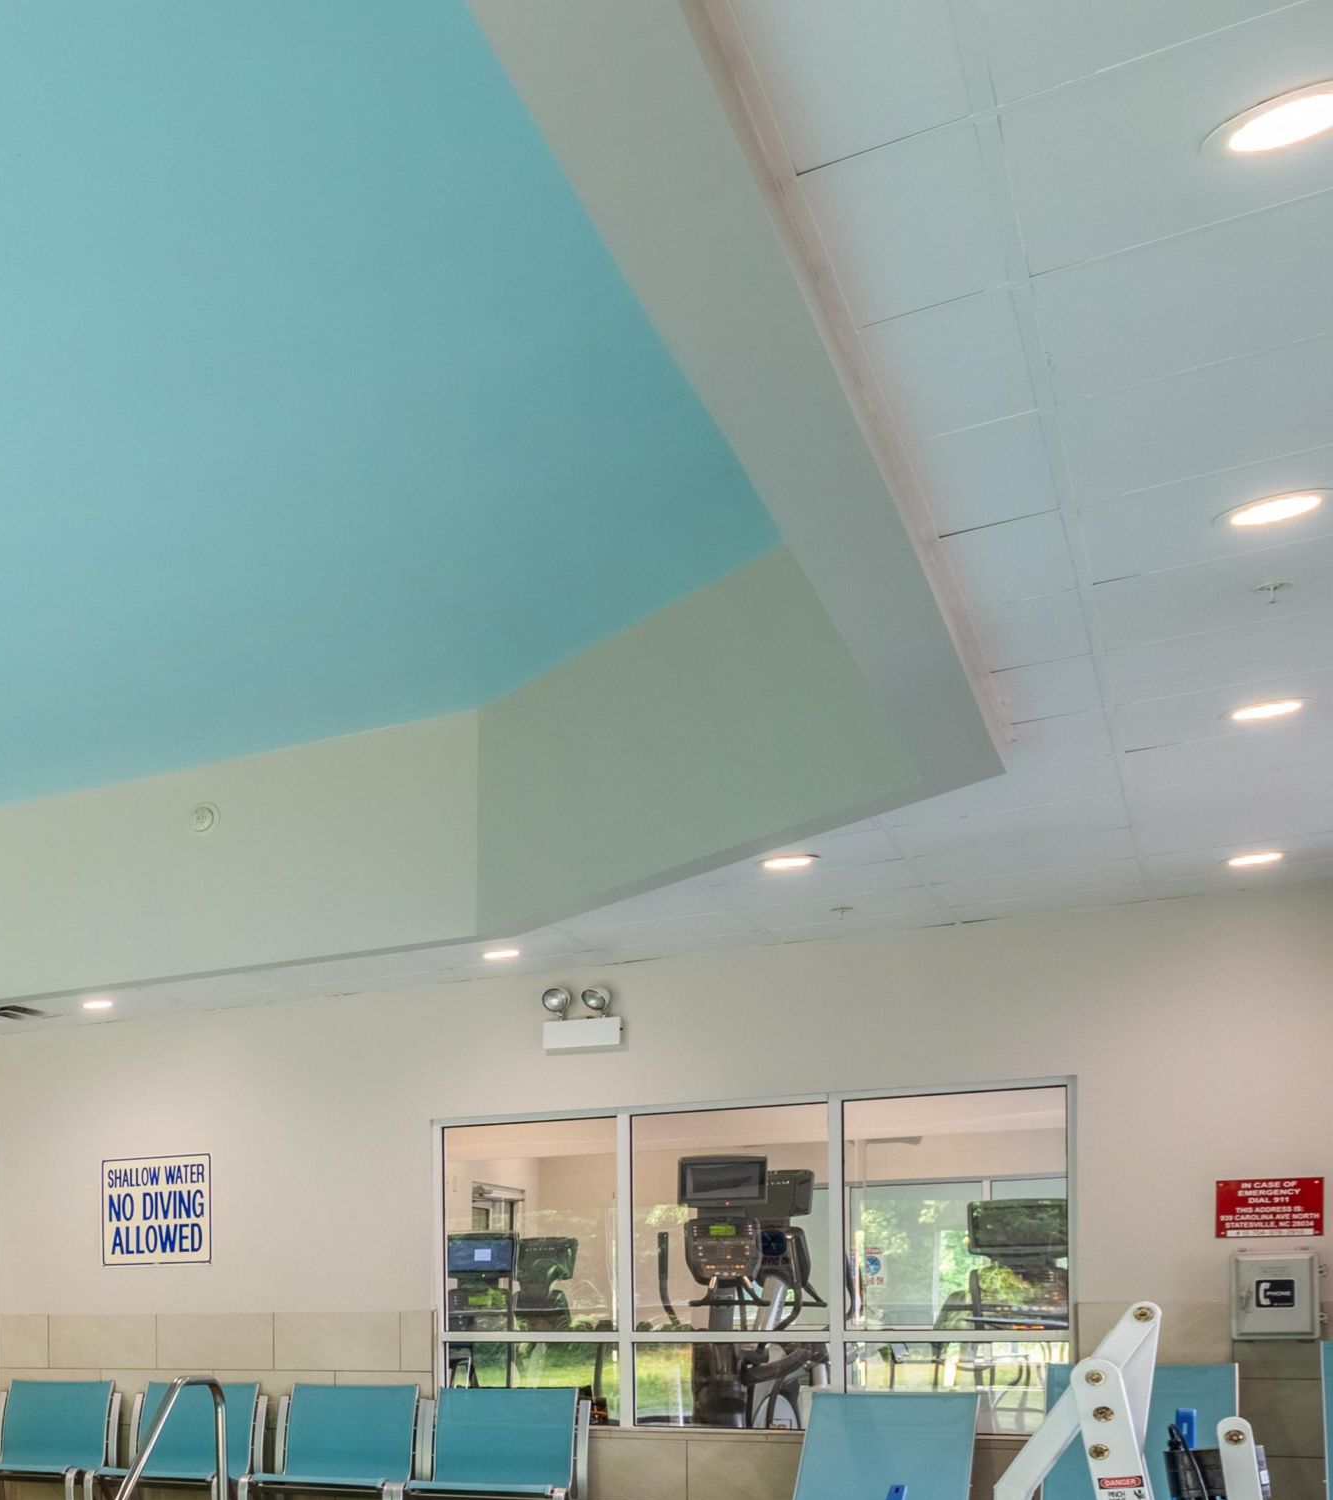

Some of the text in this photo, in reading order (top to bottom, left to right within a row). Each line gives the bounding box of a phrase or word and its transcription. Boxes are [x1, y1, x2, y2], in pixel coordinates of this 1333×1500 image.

[107, 1163, 205, 1188] SHALLOW WATER
[1237, 1188, 1301, 1197] EMERGENCY
[108, 1189, 205, 1222] NO DIVING
[1292, 1212, 1320, 1220] NORTH
[111, 1223, 203, 1256] ALLOWED
[1104, 1478, 1136, 1487] DANGER
